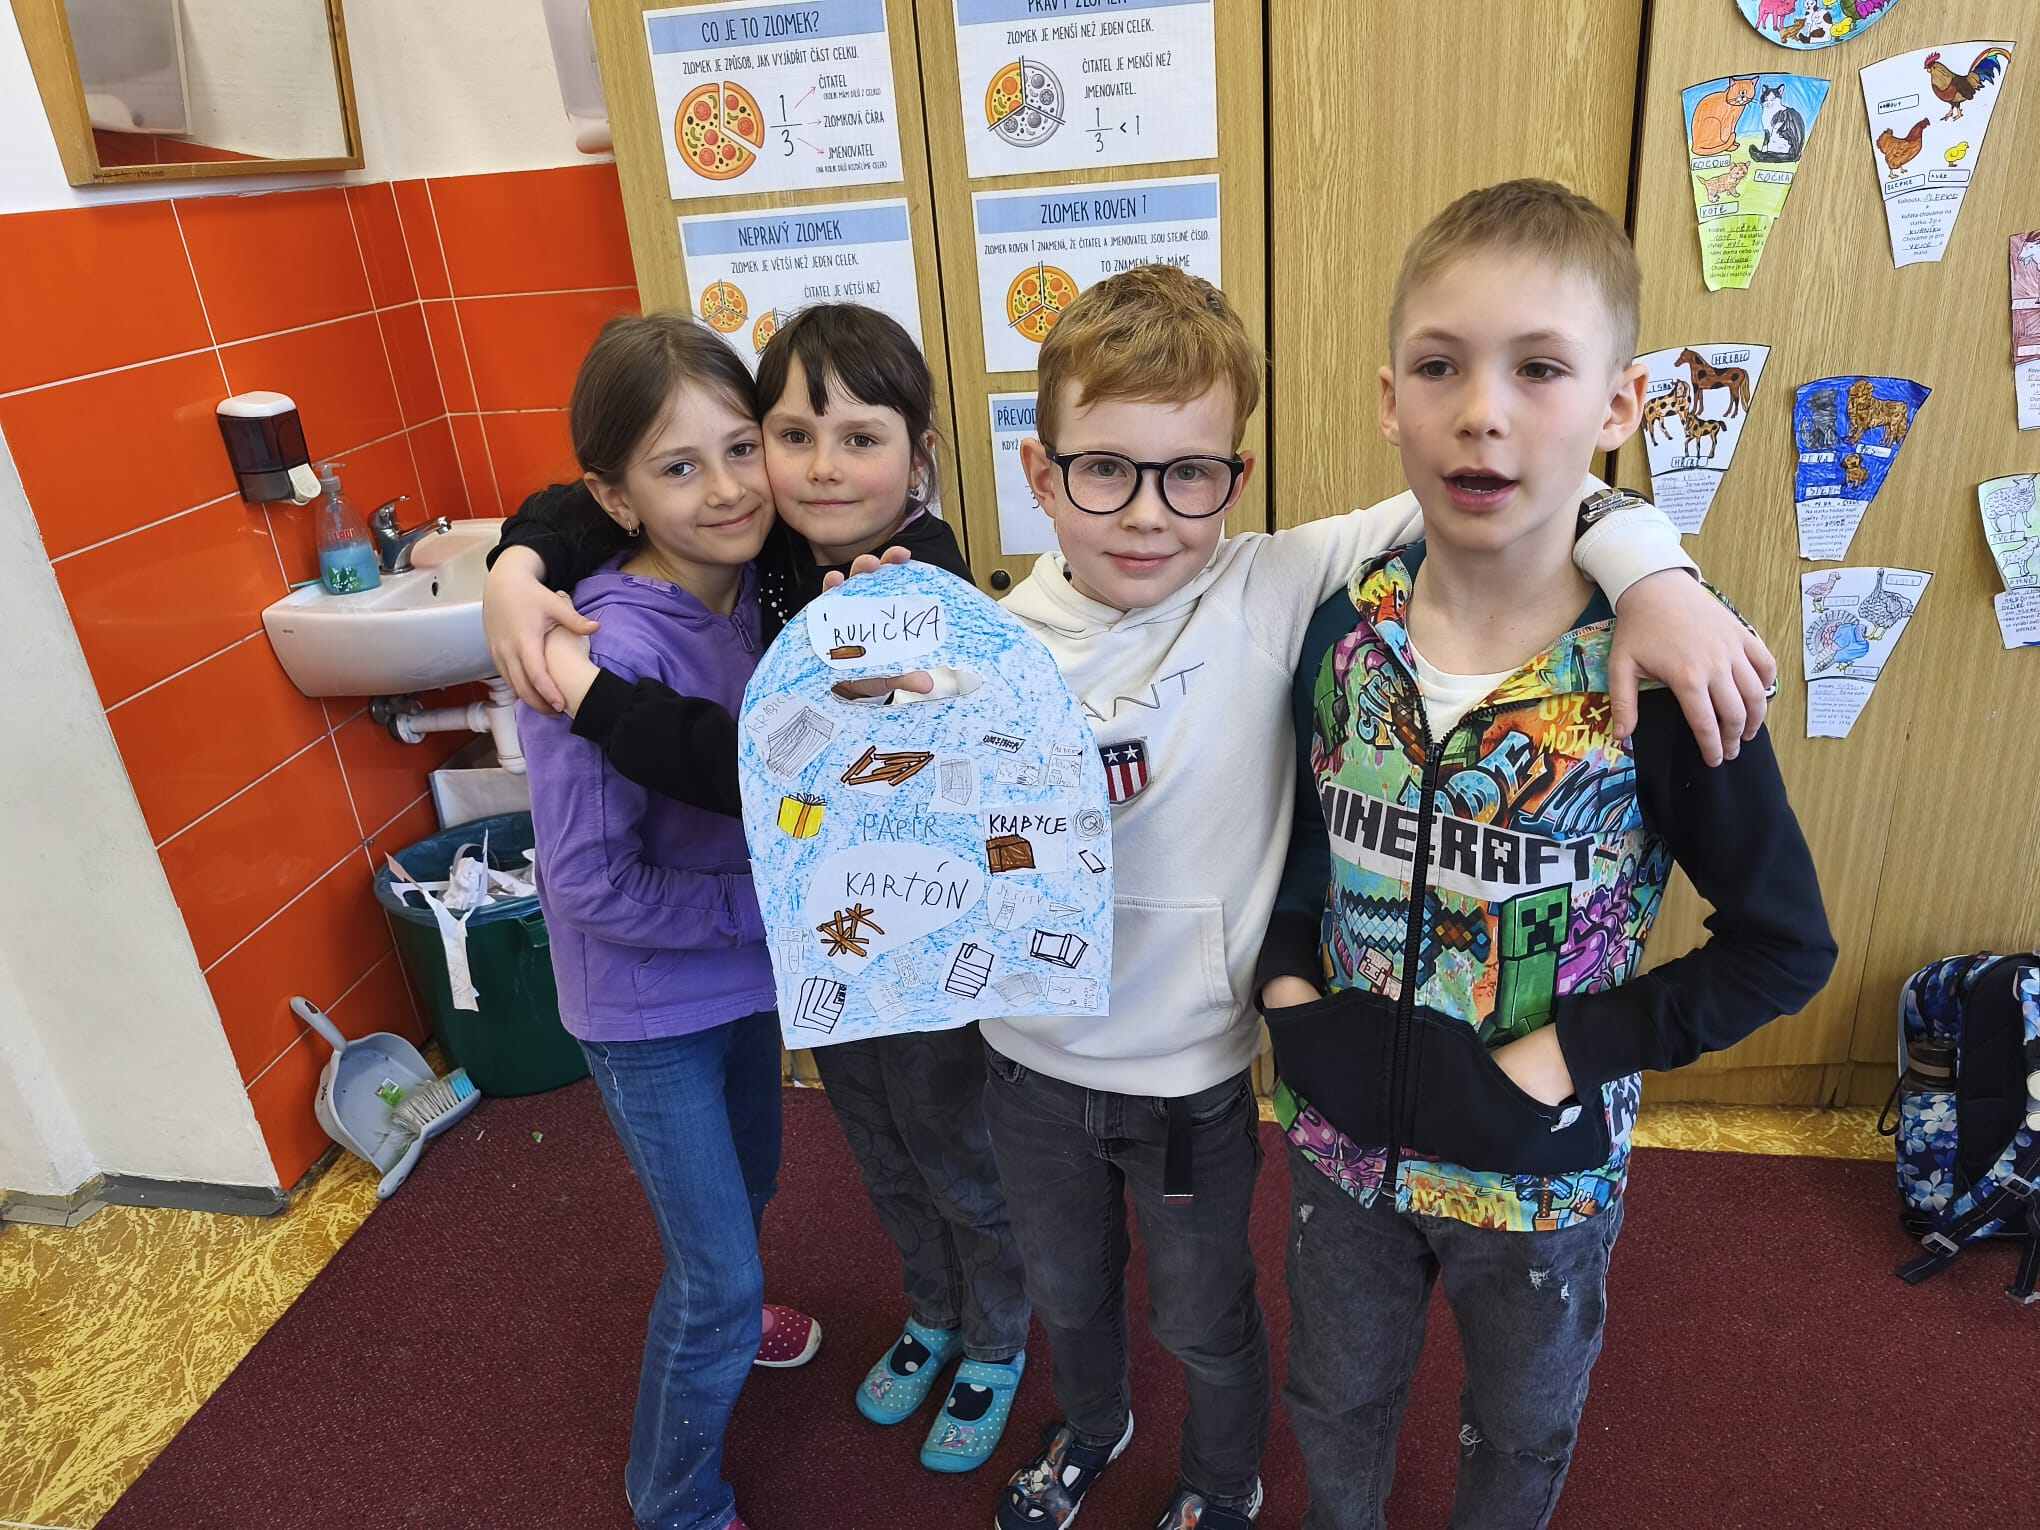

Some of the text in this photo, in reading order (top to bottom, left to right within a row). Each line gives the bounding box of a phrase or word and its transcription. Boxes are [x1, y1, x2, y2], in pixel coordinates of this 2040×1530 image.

[702, 11, 820, 43] CO JE TO ZLOMEK?
[1007, 18, 1155, 44] ZLOMEK JE MENŠÍ NEŽ JEDEN CELEK.
[683, 46, 859, 75] ZLOMEK JE ZPŮSOB, JAK VYJÁDŘIT ČÁST CELKU.
[1083, 51, 1172, 73] ČITATEL JE MENŠÍ NEŽ
[818, 74, 847, 89] ČITATEL
[1085, 83, 1136, 99] JMENOVATEL.
[779, 94, 787, 122] 1
[823, 109, 885, 128] ZLOMKOVÁ ČÁRA
[1095, 107, 1101, 128] 1
[1135, 115, 1141, 136] 1
[781, 129, 795, 157] 3
[828, 143, 875, 159] JMENOVATEL
[1095, 132, 1105, 153] 3
[1040, 194, 1147, 225] ZLOMEK ROVEN 1
[738, 220, 843, 247] NEPRAVÝ ZLOMEK
[985, 245, 1007, 255] ZLOMEK
[1009, 243, 1028, 253] ROVEN
[1070, 237, 1077, 249] ŽE
[1079, 236, 1102, 249] ČITATEL
[1104, 238, 1108, 247] A
[1111, 234, 1147, 247] JMENOVATEL
[1151, 233, 1165, 244] JSOU
[1167, 230, 1188, 242] STEJNÉ
[731, 253, 860, 274] ZLOMEK JE VĚTŠÍ NEŽ JEDEN CELEK.
[1102, 260, 1111, 272] TO
[1168, 253, 1190, 267] MÁME
[804, 280, 881, 298] ČITATEL JE VĚTŠÍ NEŽ
[1002, 438, 1018, 451] KDYŽ
[846, 861, 969, 910] KARTÓN
